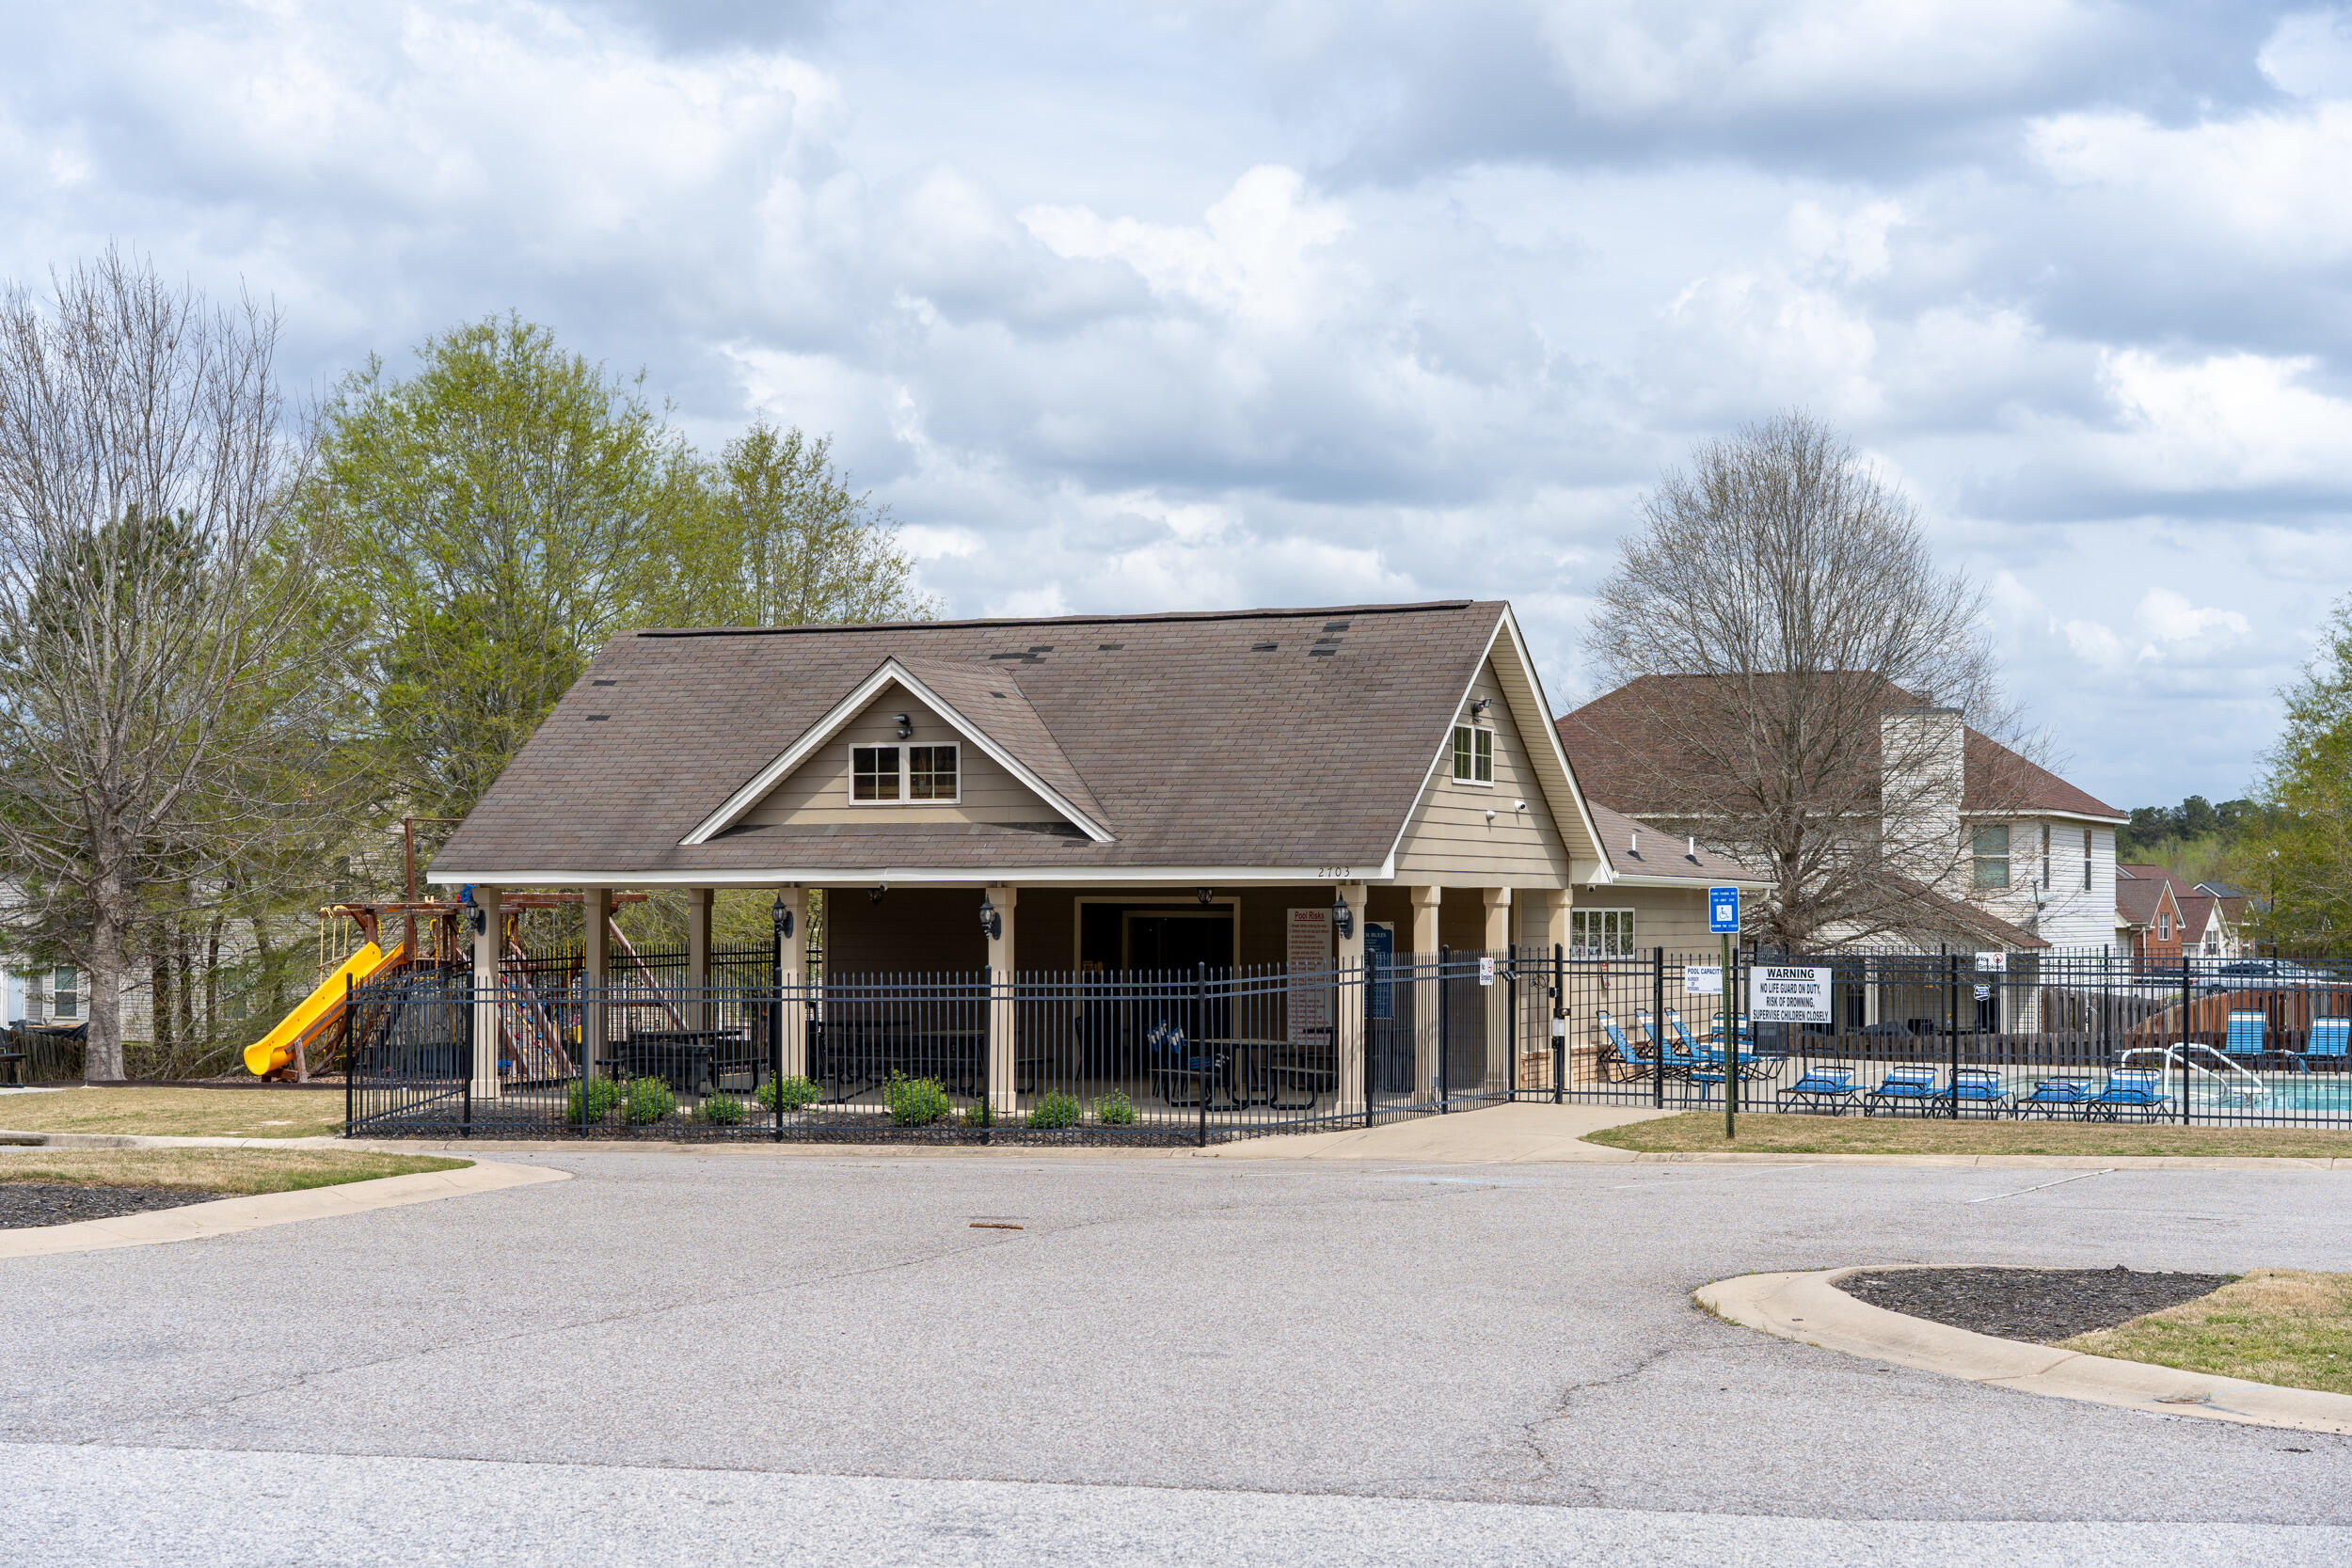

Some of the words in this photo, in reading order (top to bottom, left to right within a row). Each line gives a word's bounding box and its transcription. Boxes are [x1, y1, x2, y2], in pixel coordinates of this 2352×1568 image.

[1318, 866, 1350, 878] 2703
[1295, 911, 1308, 920] Pool
[1309, 911, 1325, 920] Risks
[1767, 968, 1815, 978] WARNING
[1760, 983, 1767, 993] NO
[1769, 983, 1779, 993] LIFE
[1780, 983, 1797, 994] GUARD
[1798, 984, 1805, 994] ON
[1806, 984, 1821, 996] DUTY,
[1766, 996, 1778, 1006] RISK
[1778, 997, 1786, 1007] OF
[1753, 1009, 1780, 1020] SUPERVISE
[1780, 1010, 1805, 1021] CHILDREN
[1806, 1010, 1829, 1022] CLOSELY
